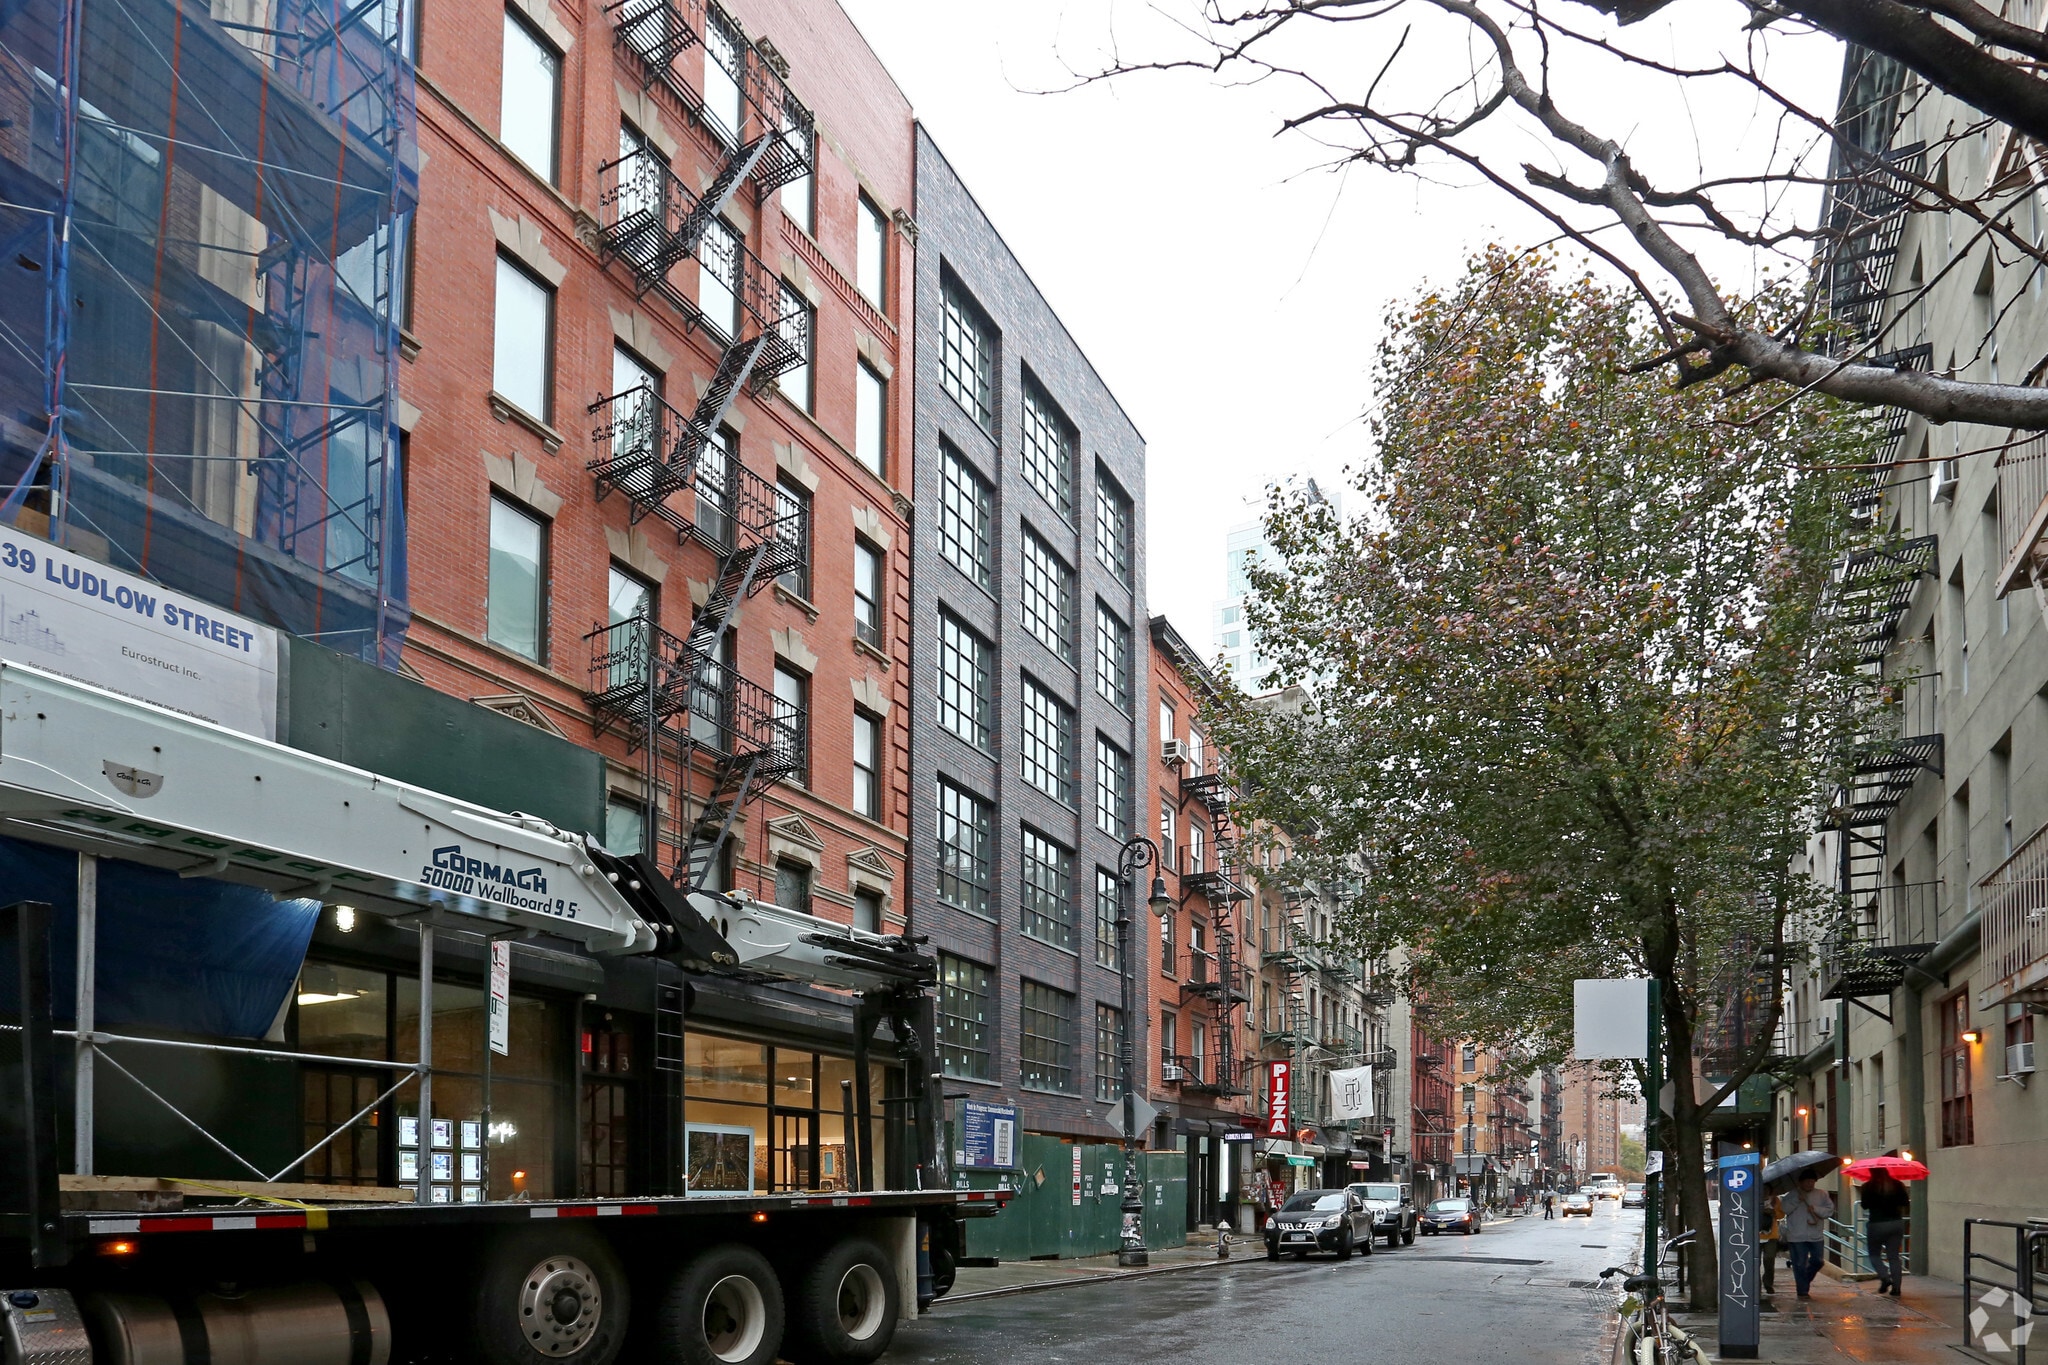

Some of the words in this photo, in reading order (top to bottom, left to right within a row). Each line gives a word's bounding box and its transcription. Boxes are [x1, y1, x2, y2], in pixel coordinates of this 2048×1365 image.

[46, 558, 157, 618] LUDLOW
[163, 603, 254, 653] STREET
[28, 661, 40, 669] For
[42, 666, 61, 676] more
[121, 646, 180, 674] Eurostruct
[182, 667, 201, 680] Inc.
[432, 845, 547, 894] CORMACH
[420, 866, 474, 894] 50000
[478, 882, 552, 914] Wallboard
[1270, 1063, 1287, 1133] PIZZA
[956, 1180, 969, 1188] BILLS
[1001, 1174, 1008, 1182] NO
[1733, 1169, 1748, 1189] P
